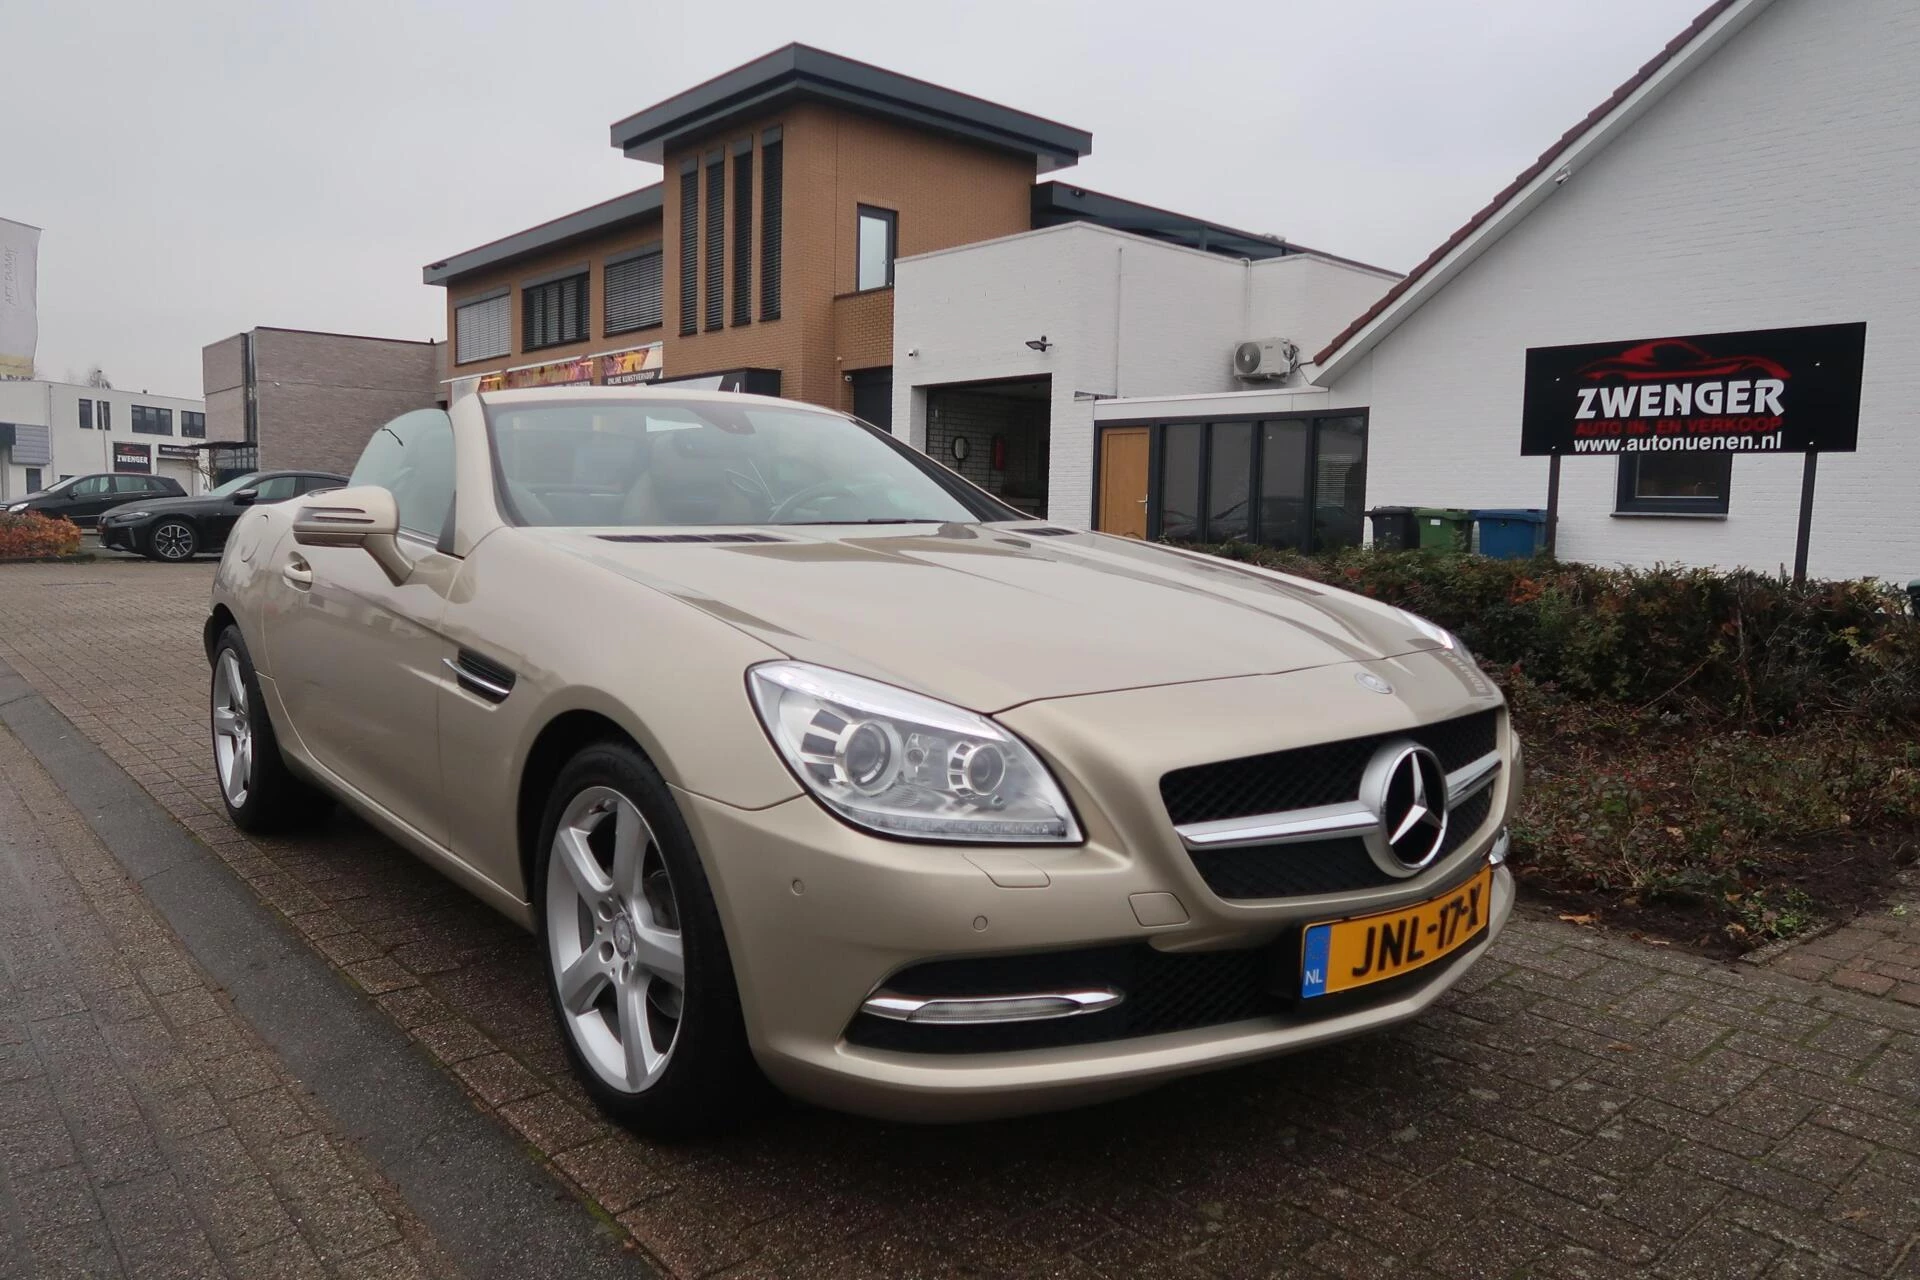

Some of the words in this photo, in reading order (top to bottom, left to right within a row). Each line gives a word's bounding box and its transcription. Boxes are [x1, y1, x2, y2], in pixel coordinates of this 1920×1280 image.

[1574, 378, 1785, 419] ZWENGER
[1575, 420, 1622, 436] AUTO
[1655, 418, 1682, 434] EN
[1684, 416, 1783, 434] VERKOOP
[1574, 431, 1782, 452] www.autonuenen.nl
[117, 454, 149, 465] ZWENGER
[1352, 883, 1482, 977] JNL-17-X
[1305, 968, 1323, 986] NL
